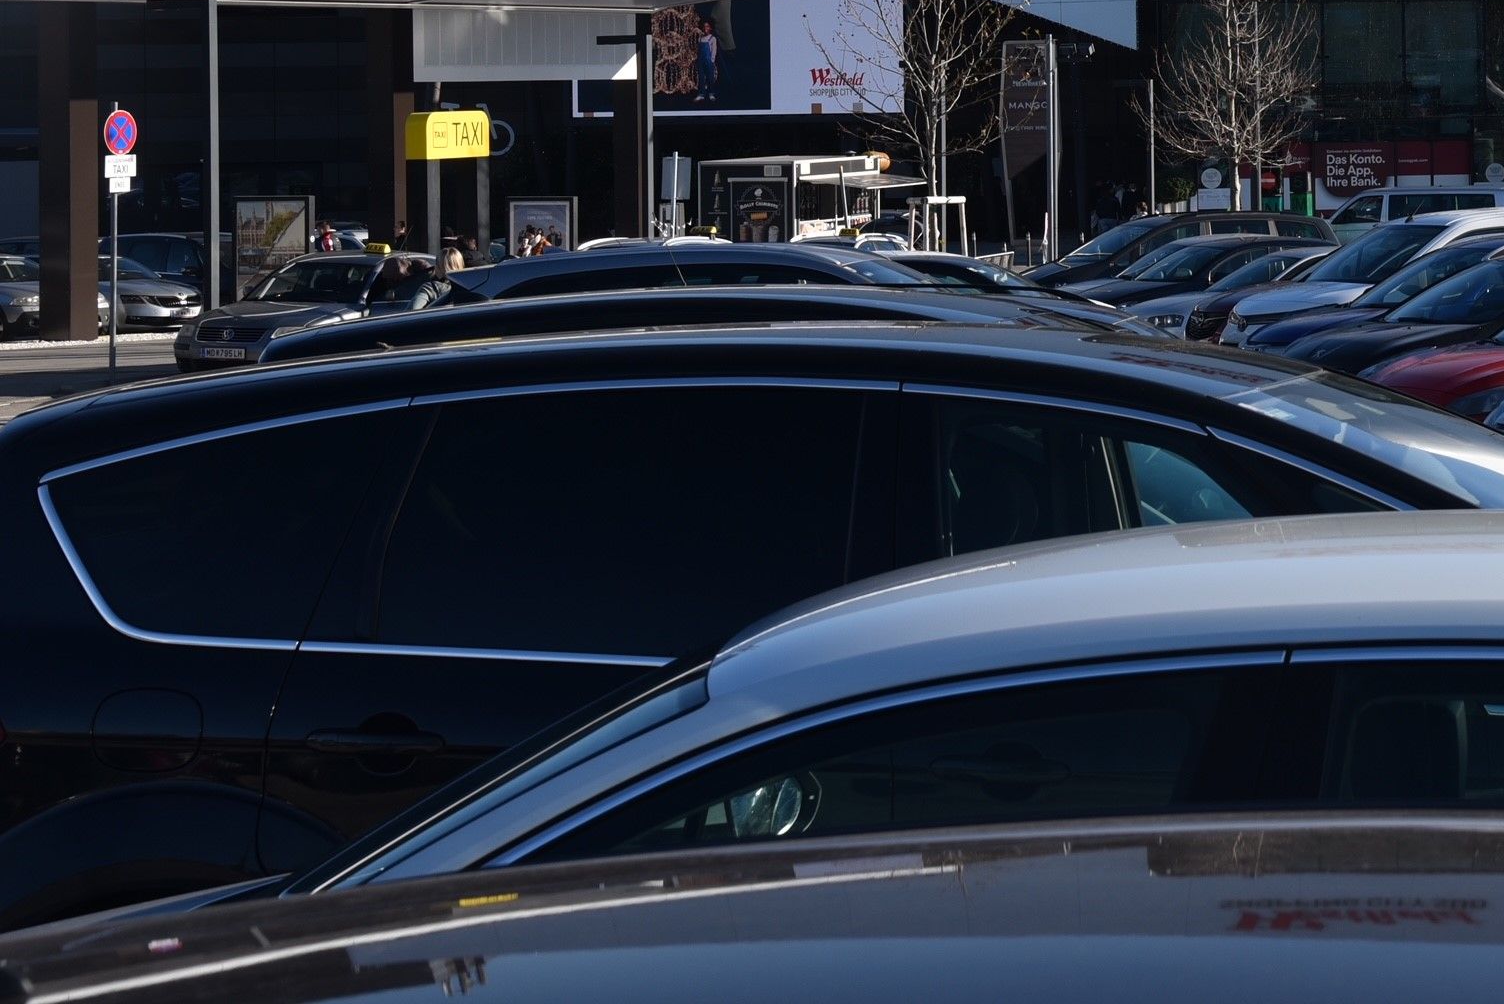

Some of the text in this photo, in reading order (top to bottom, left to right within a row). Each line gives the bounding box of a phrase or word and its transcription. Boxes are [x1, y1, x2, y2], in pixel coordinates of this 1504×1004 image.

[809, 67, 865, 87] Westfield
[452, 121, 483, 147] TAXI
[1326, 154, 1386, 165] Das Konto.
[113, 164, 129, 174] TAXI
[1326, 165, 1374, 177] Die App.
[1326, 176, 1381, 187] Ihre Bank.
